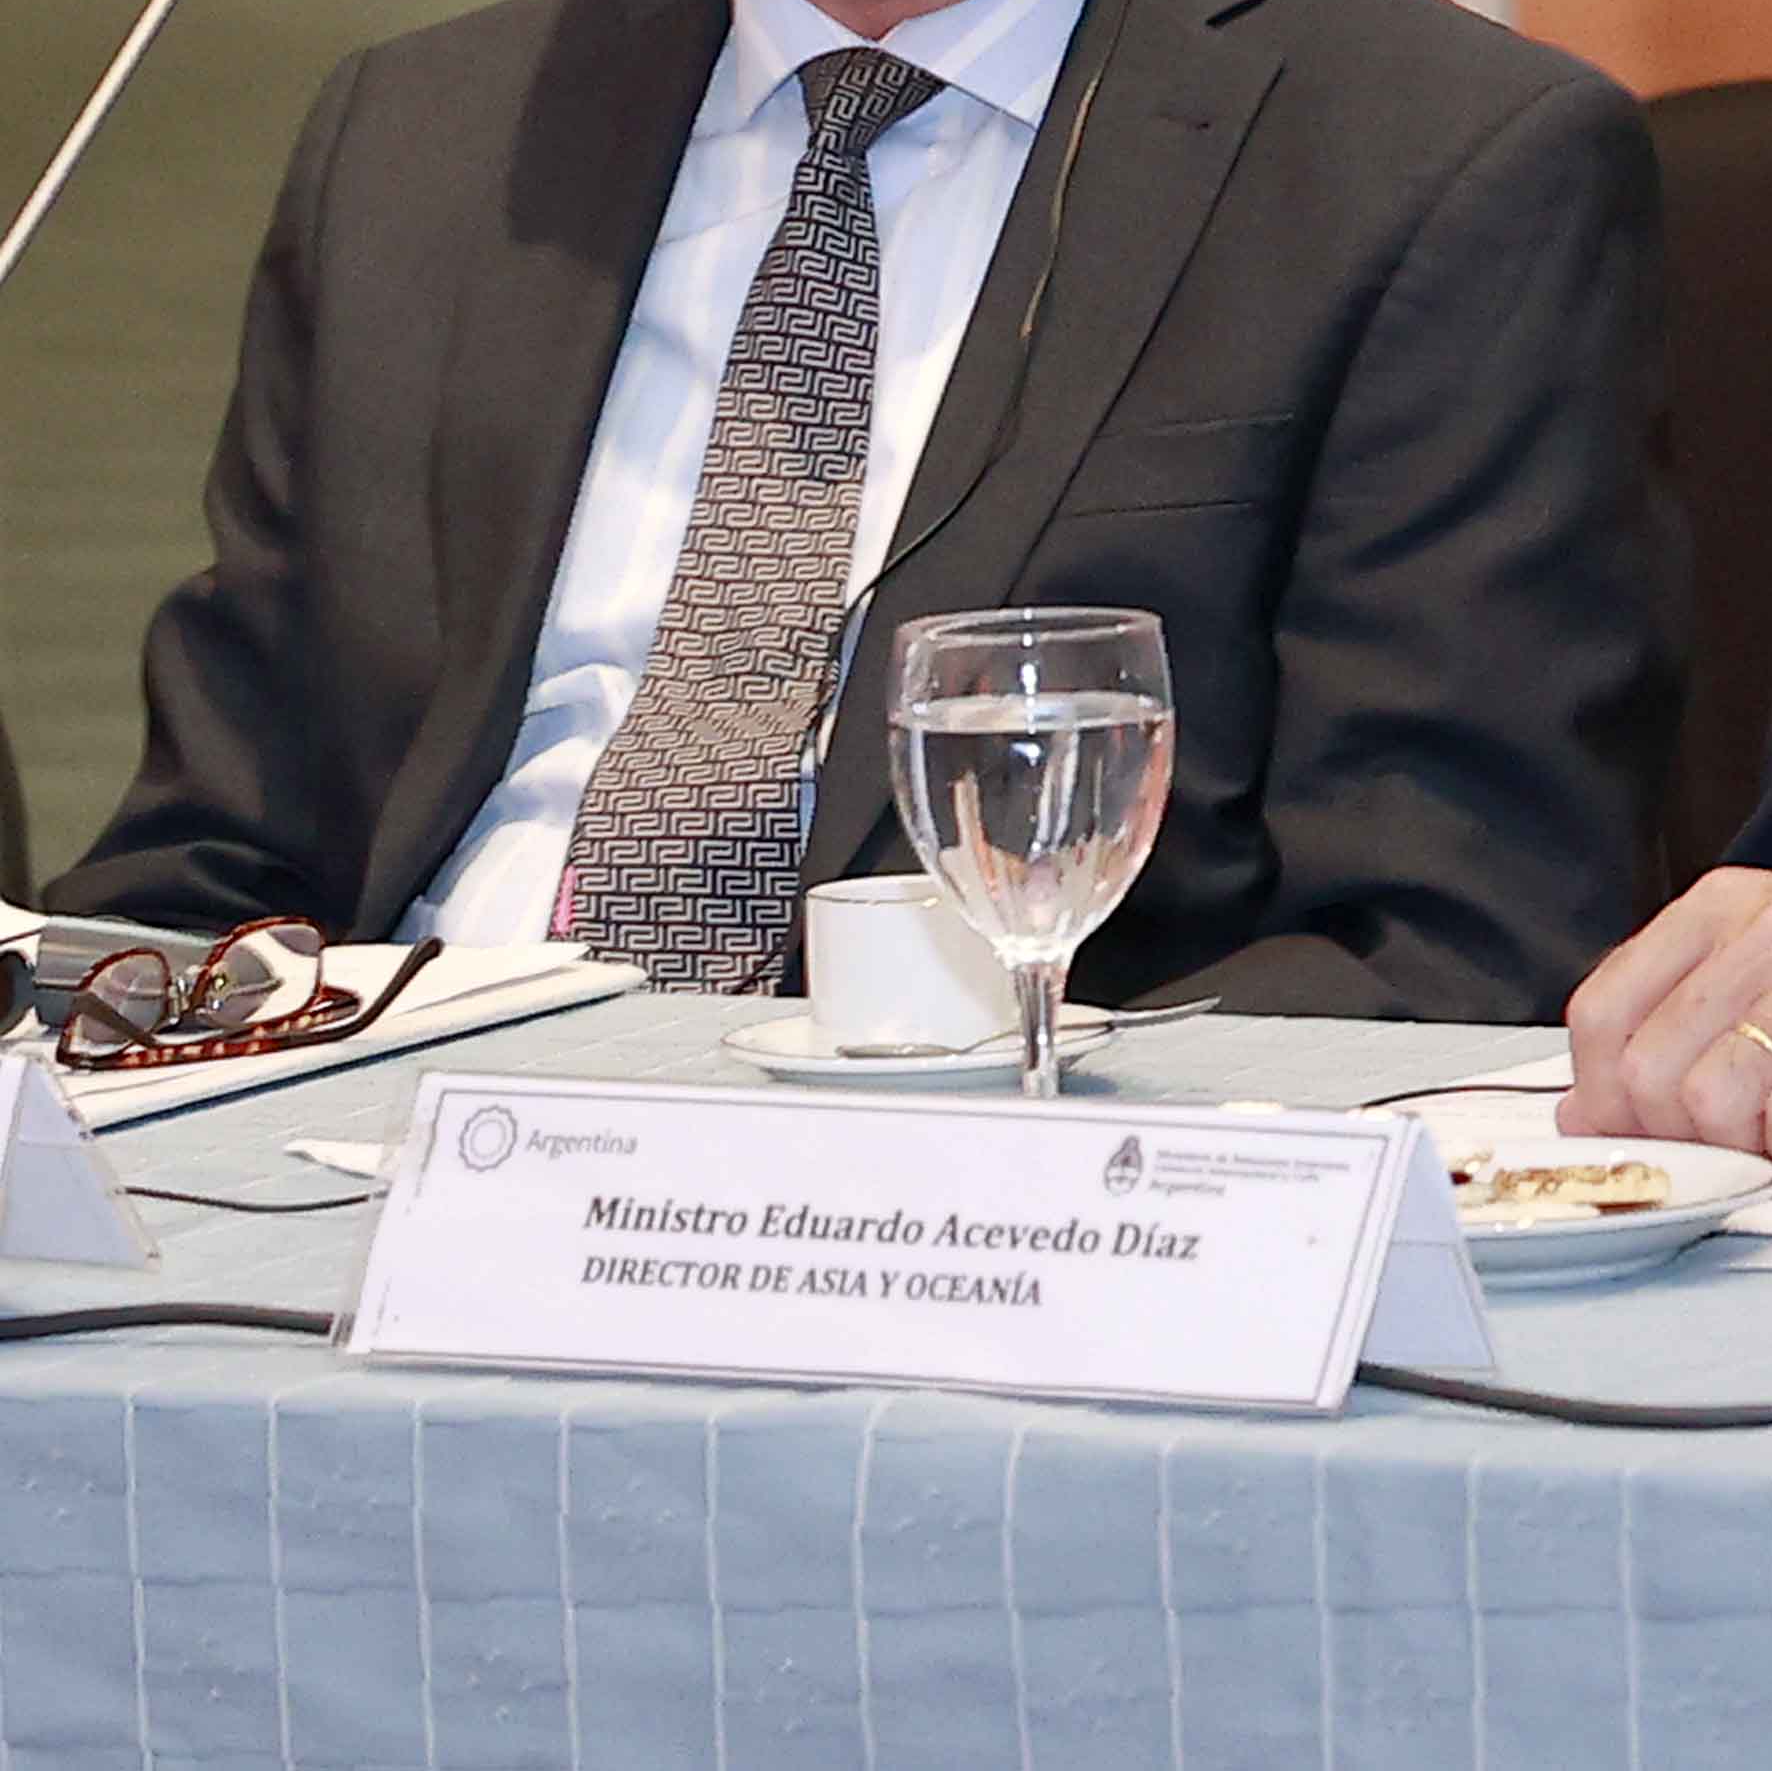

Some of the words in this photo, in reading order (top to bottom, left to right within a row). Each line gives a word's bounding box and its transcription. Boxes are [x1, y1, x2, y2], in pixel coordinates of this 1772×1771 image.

[525, 1128, 638, 1159] Argentina
[584, 1195, 748, 1236] Ministro
[758, 1204, 925, 1245] Eduardo
[933, 1213, 1101, 1254] Acevedo
[1111, 1221, 1201, 1260] Díaz
[581, 1256, 742, 1290] DIRECTOR
[748, 1264, 793, 1292] DE
[797, 1268, 867, 1297] ASIA
[880, 1271, 901, 1299] Y
[905, 1271, 1041, 1306] OCEANÍA
